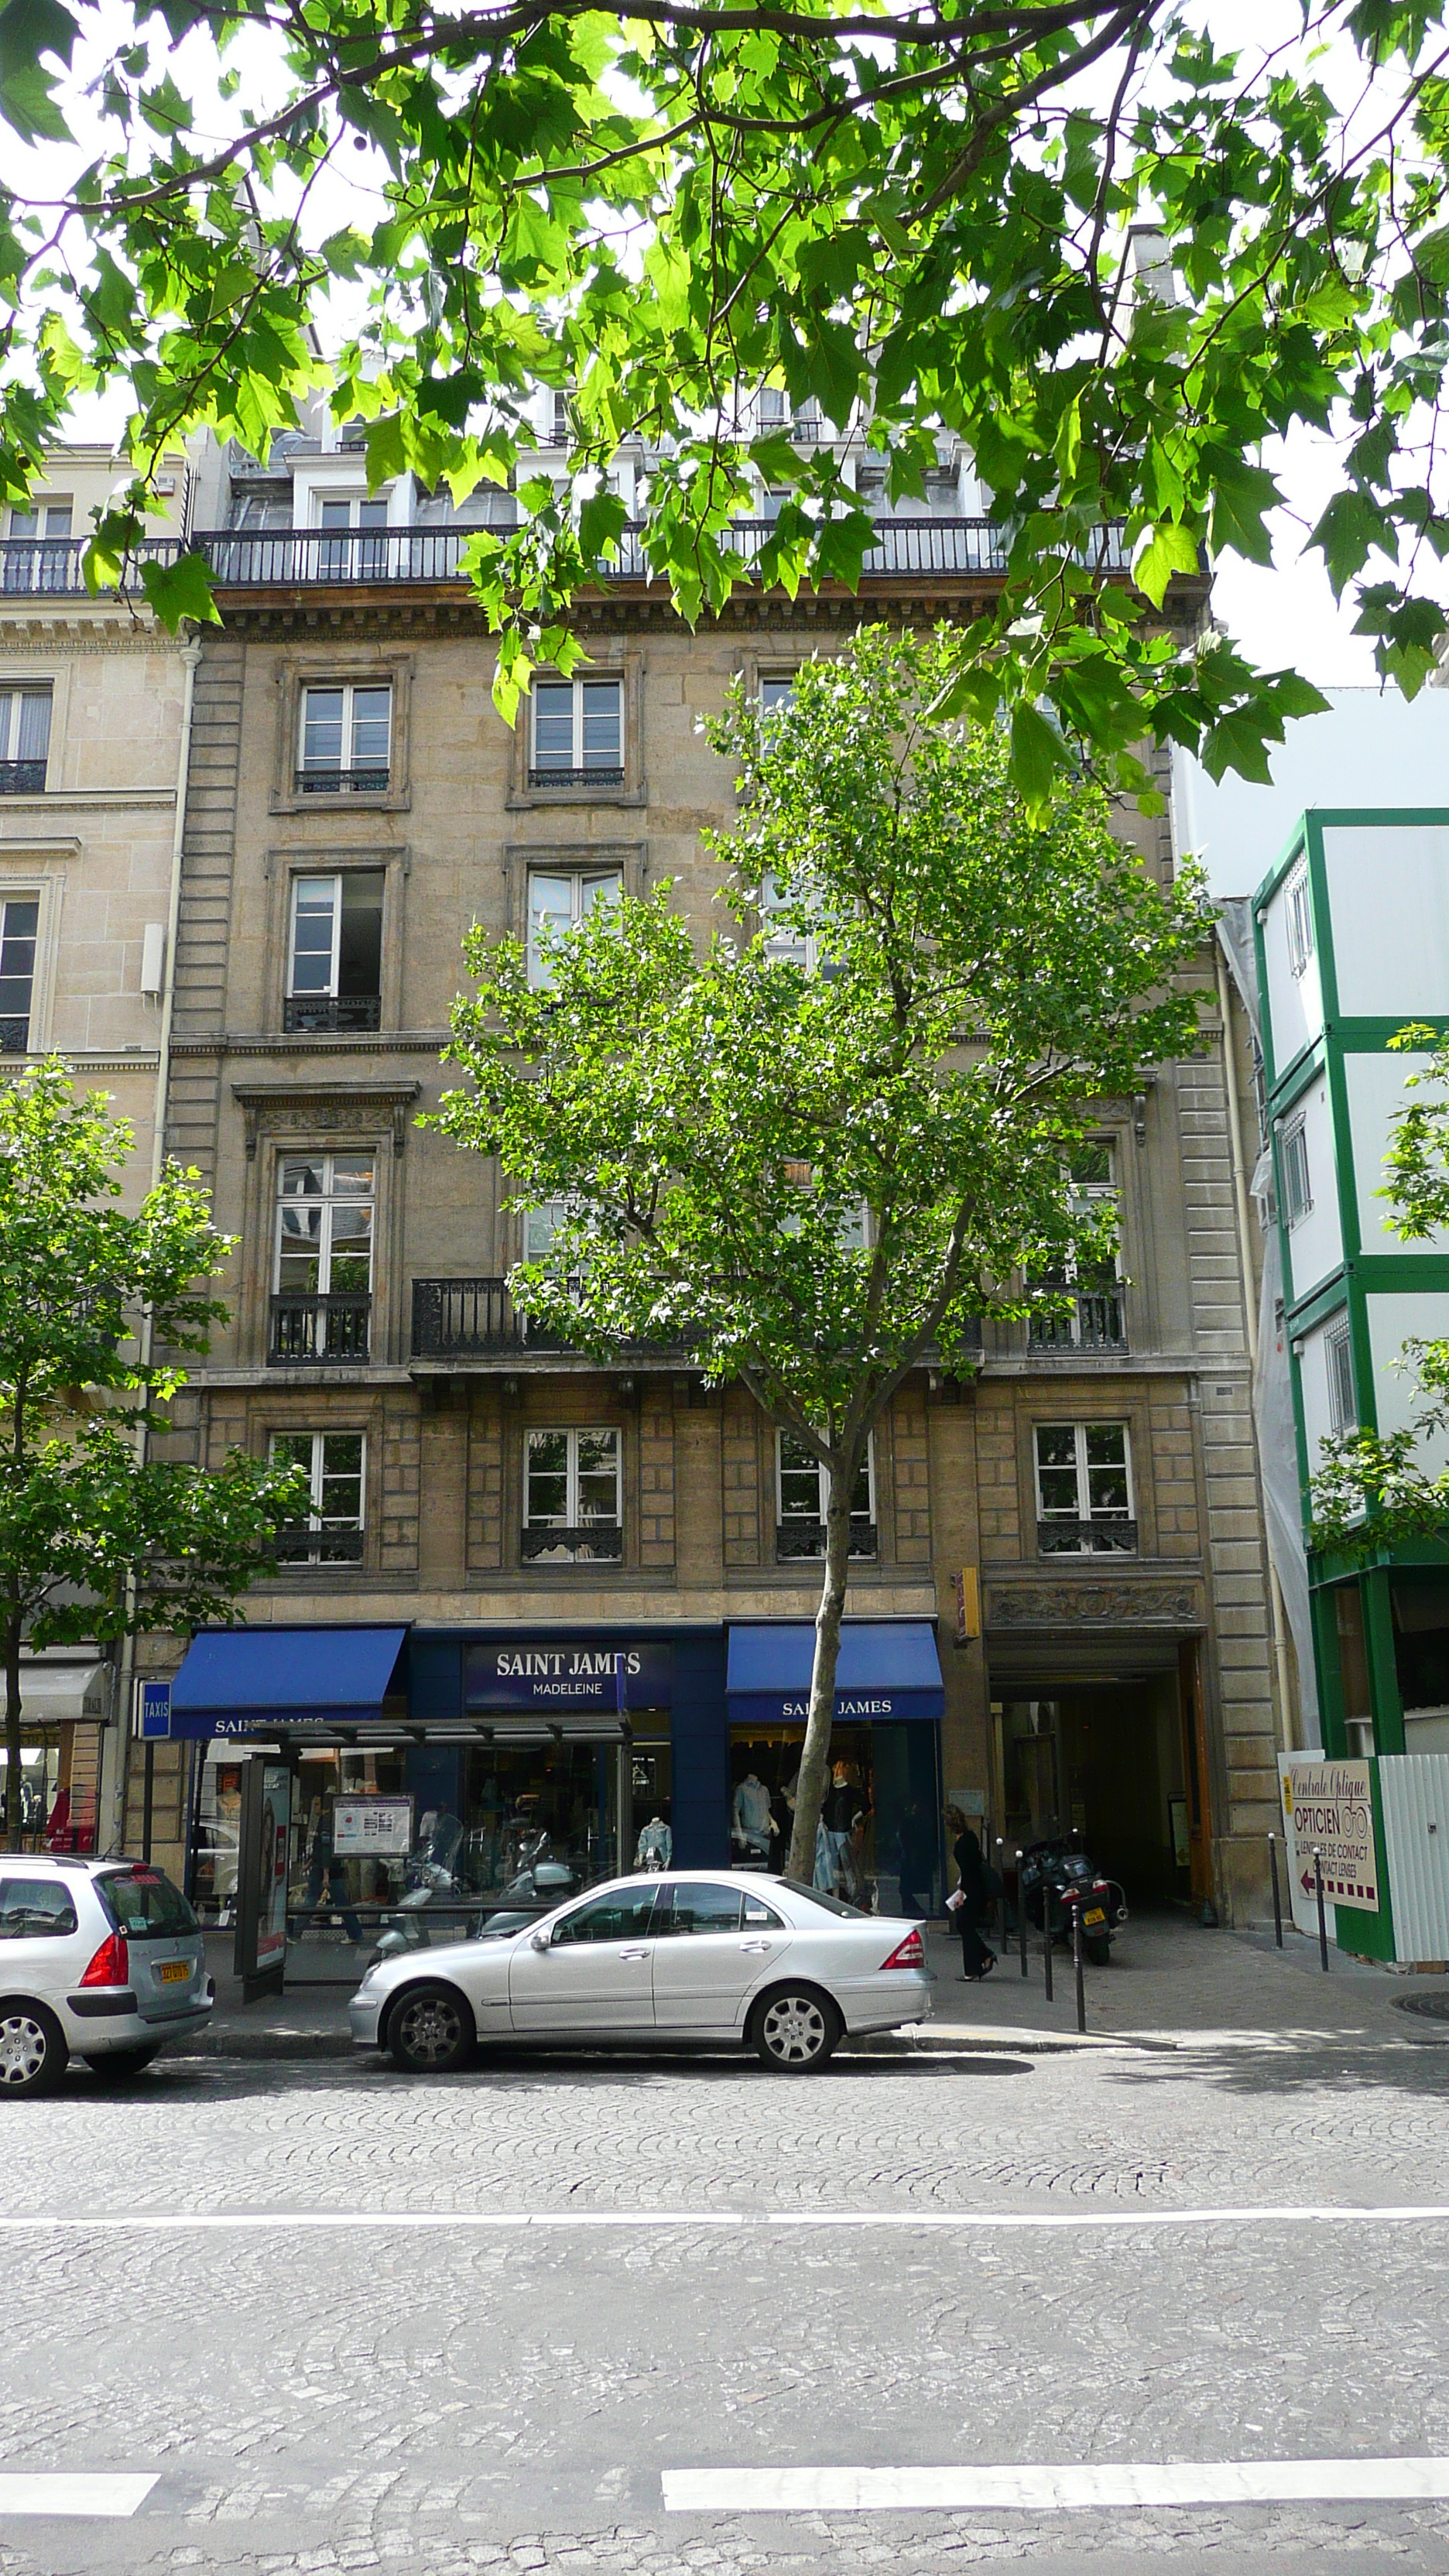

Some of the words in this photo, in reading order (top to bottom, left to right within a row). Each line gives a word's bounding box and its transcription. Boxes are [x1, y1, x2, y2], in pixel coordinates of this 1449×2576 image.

[497, 1653, 565, 1676] SAINT
[533, 1683, 603, 1695] MADELEINE
[144, 1701, 169, 1718] TAXIS
[783, 1702, 811, 1716] SAI
[838, 1700, 892, 1714] JAMES
[1290, 1768, 1327, 1797] Centrale
[1330, 1767, 1365, 1809] Optique
[1294, 1807, 1341, 1834] OPTICIEN
[1327, 1842, 1336, 1858] DE
[1337, 1843, 1368, 1862] CONTACT
[1313, 1859, 1338, 1876] CNTACT
[1338, 1861, 1357, 1879] LENSES
